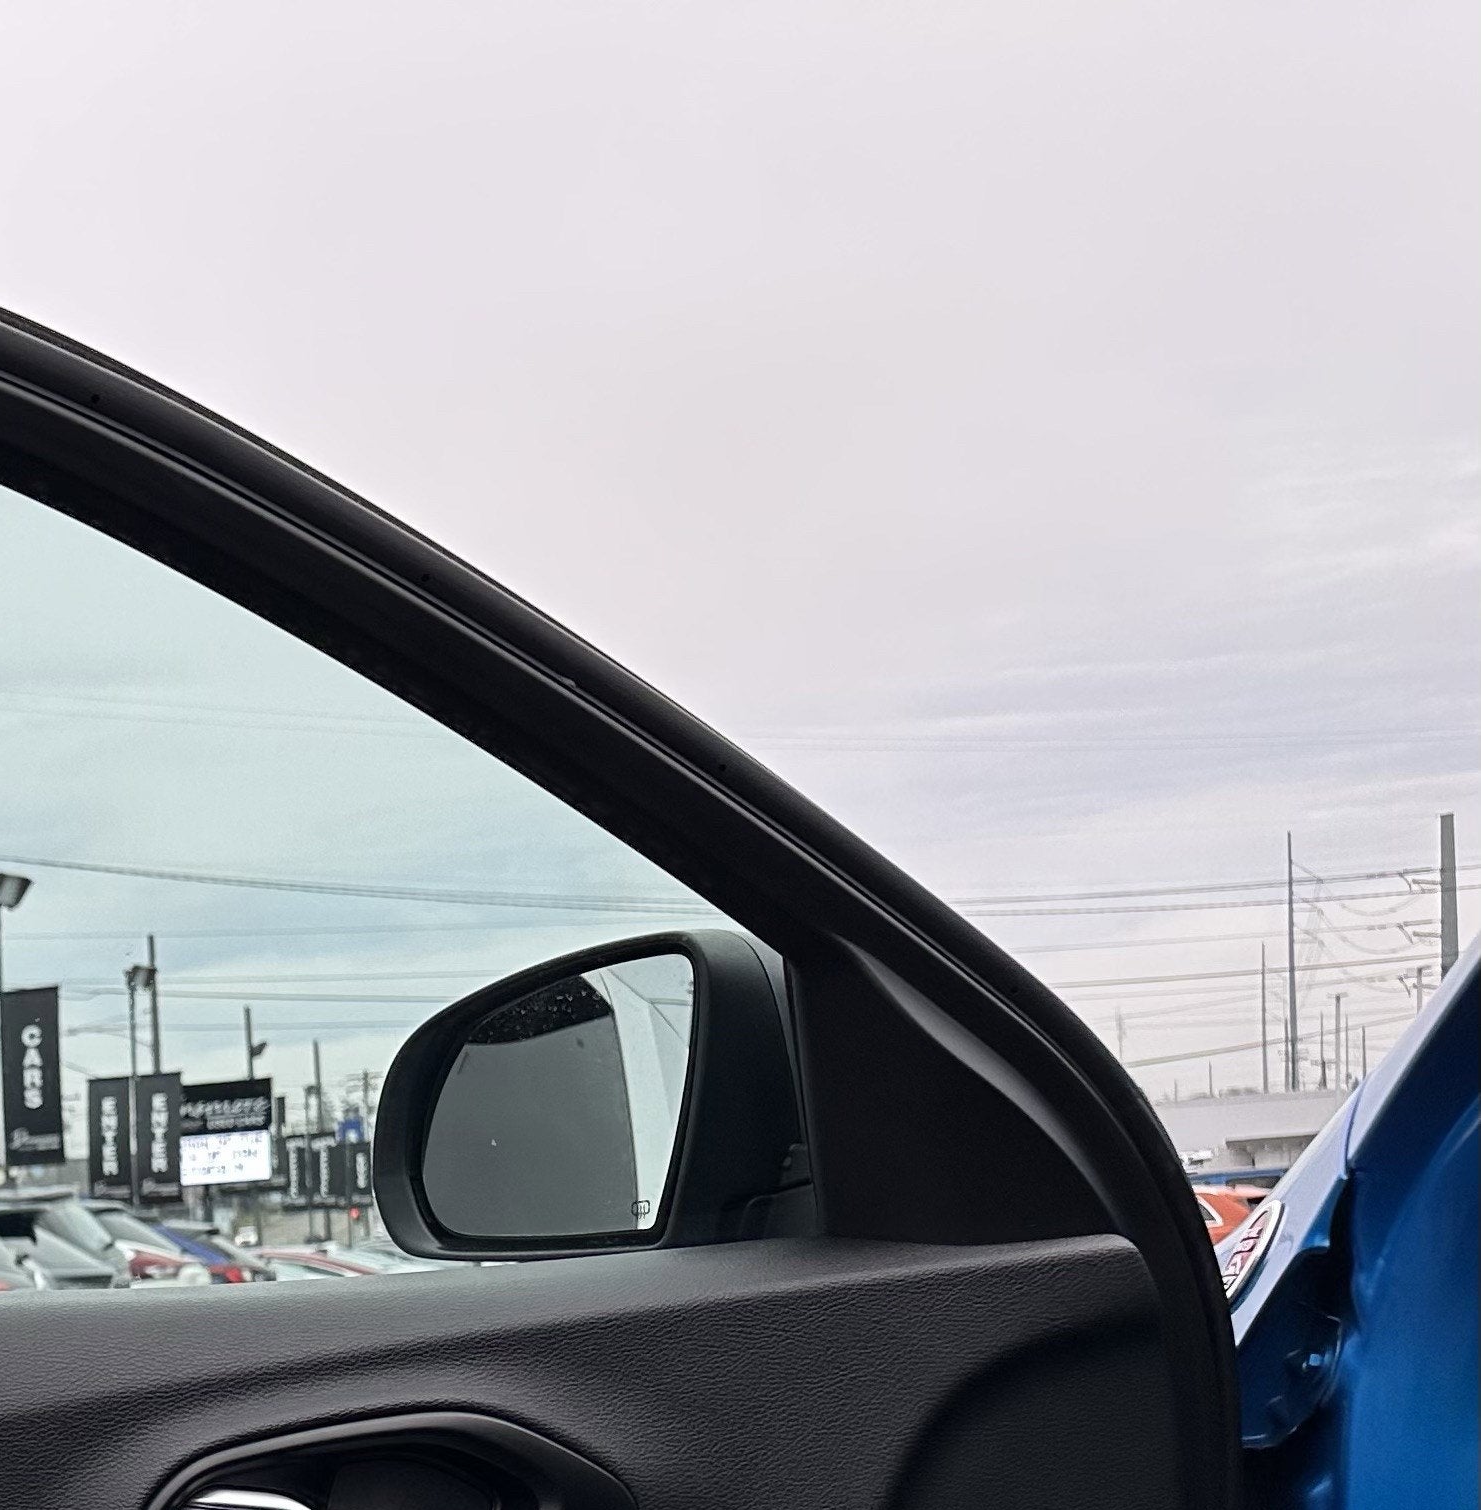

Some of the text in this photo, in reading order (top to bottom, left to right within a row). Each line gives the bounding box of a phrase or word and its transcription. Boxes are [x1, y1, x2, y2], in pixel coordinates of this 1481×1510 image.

[21, 1024, 43, 1109] CARS
[101, 1096, 118, 1174] ENTER
[151, 1092, 168, 1173] ENTER
